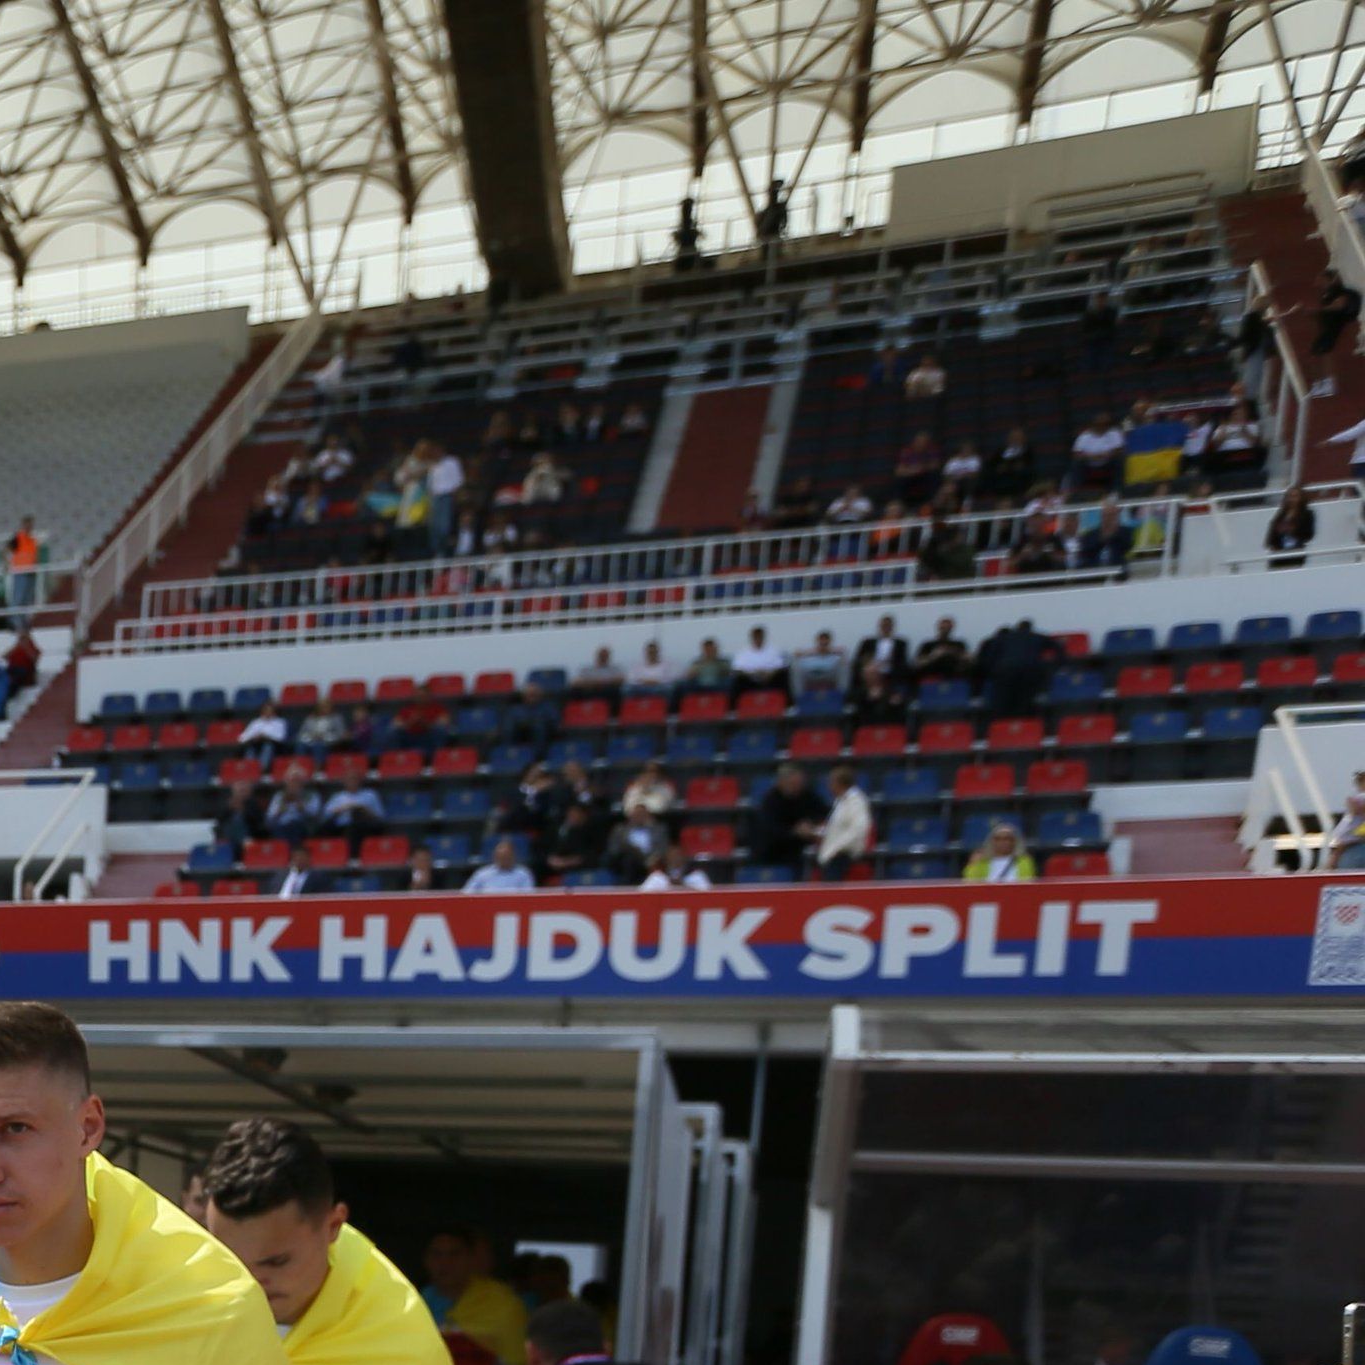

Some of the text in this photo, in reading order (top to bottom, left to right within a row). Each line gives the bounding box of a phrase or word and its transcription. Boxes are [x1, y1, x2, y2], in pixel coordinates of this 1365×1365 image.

[88, 900, 1159, 983] HNK HAJDUK SPLIT
